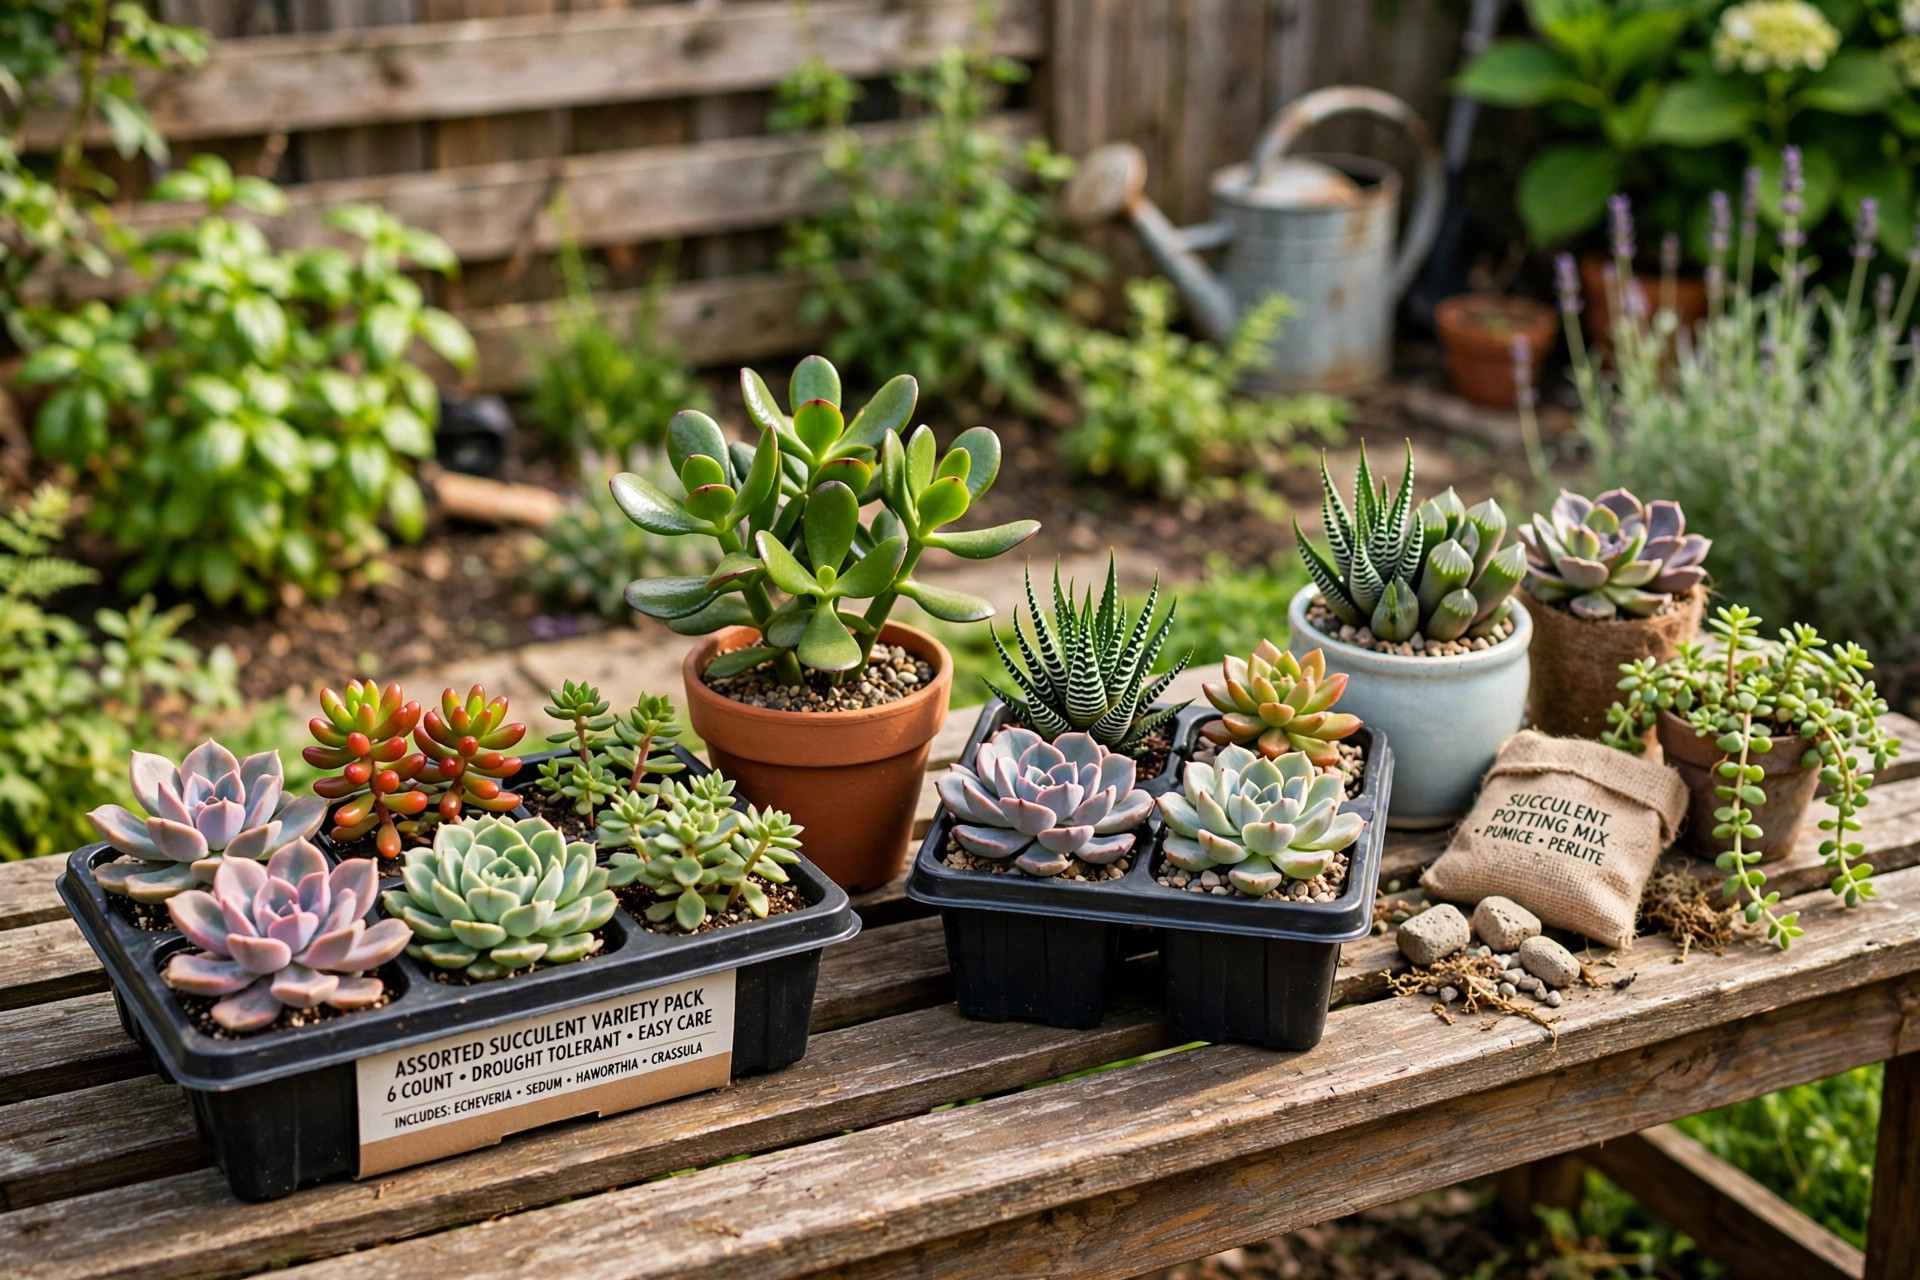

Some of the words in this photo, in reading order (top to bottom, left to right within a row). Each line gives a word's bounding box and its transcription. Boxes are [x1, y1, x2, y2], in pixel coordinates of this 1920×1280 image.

[1491, 808, 1569, 834] POTTING
[1572, 823, 1610, 848] MIX
[1506, 793, 1612, 827] SUCCULENT
[1482, 825, 1534, 845] PUMICE
[1547, 836, 1605, 867] PERLITE
[387, 1085, 397, 1103] 6
[401, 1071, 454, 1099] COUNT
[472, 1049, 544, 1082] DROUGHT
[547, 1030, 622, 1063] TOLERANT
[638, 1017, 674, 1041] EASY
[677, 1008, 713, 1031] CARE
[395, 1041, 485, 1079] ASSORTED
[489, 1015, 587, 1056] SUCCULENT
[591, 998, 660, 1031] VARIETY
[664, 987, 705, 1014] PACK
[394, 1104, 451, 1129] INCLUDES:
[454, 1088, 513, 1114] ECHEVERIA
[526, 1076, 563, 1096] SEDUM
[576, 1058, 639, 1084] HAWORTHIA
[651, 1041, 703, 1065] CRASSULA
